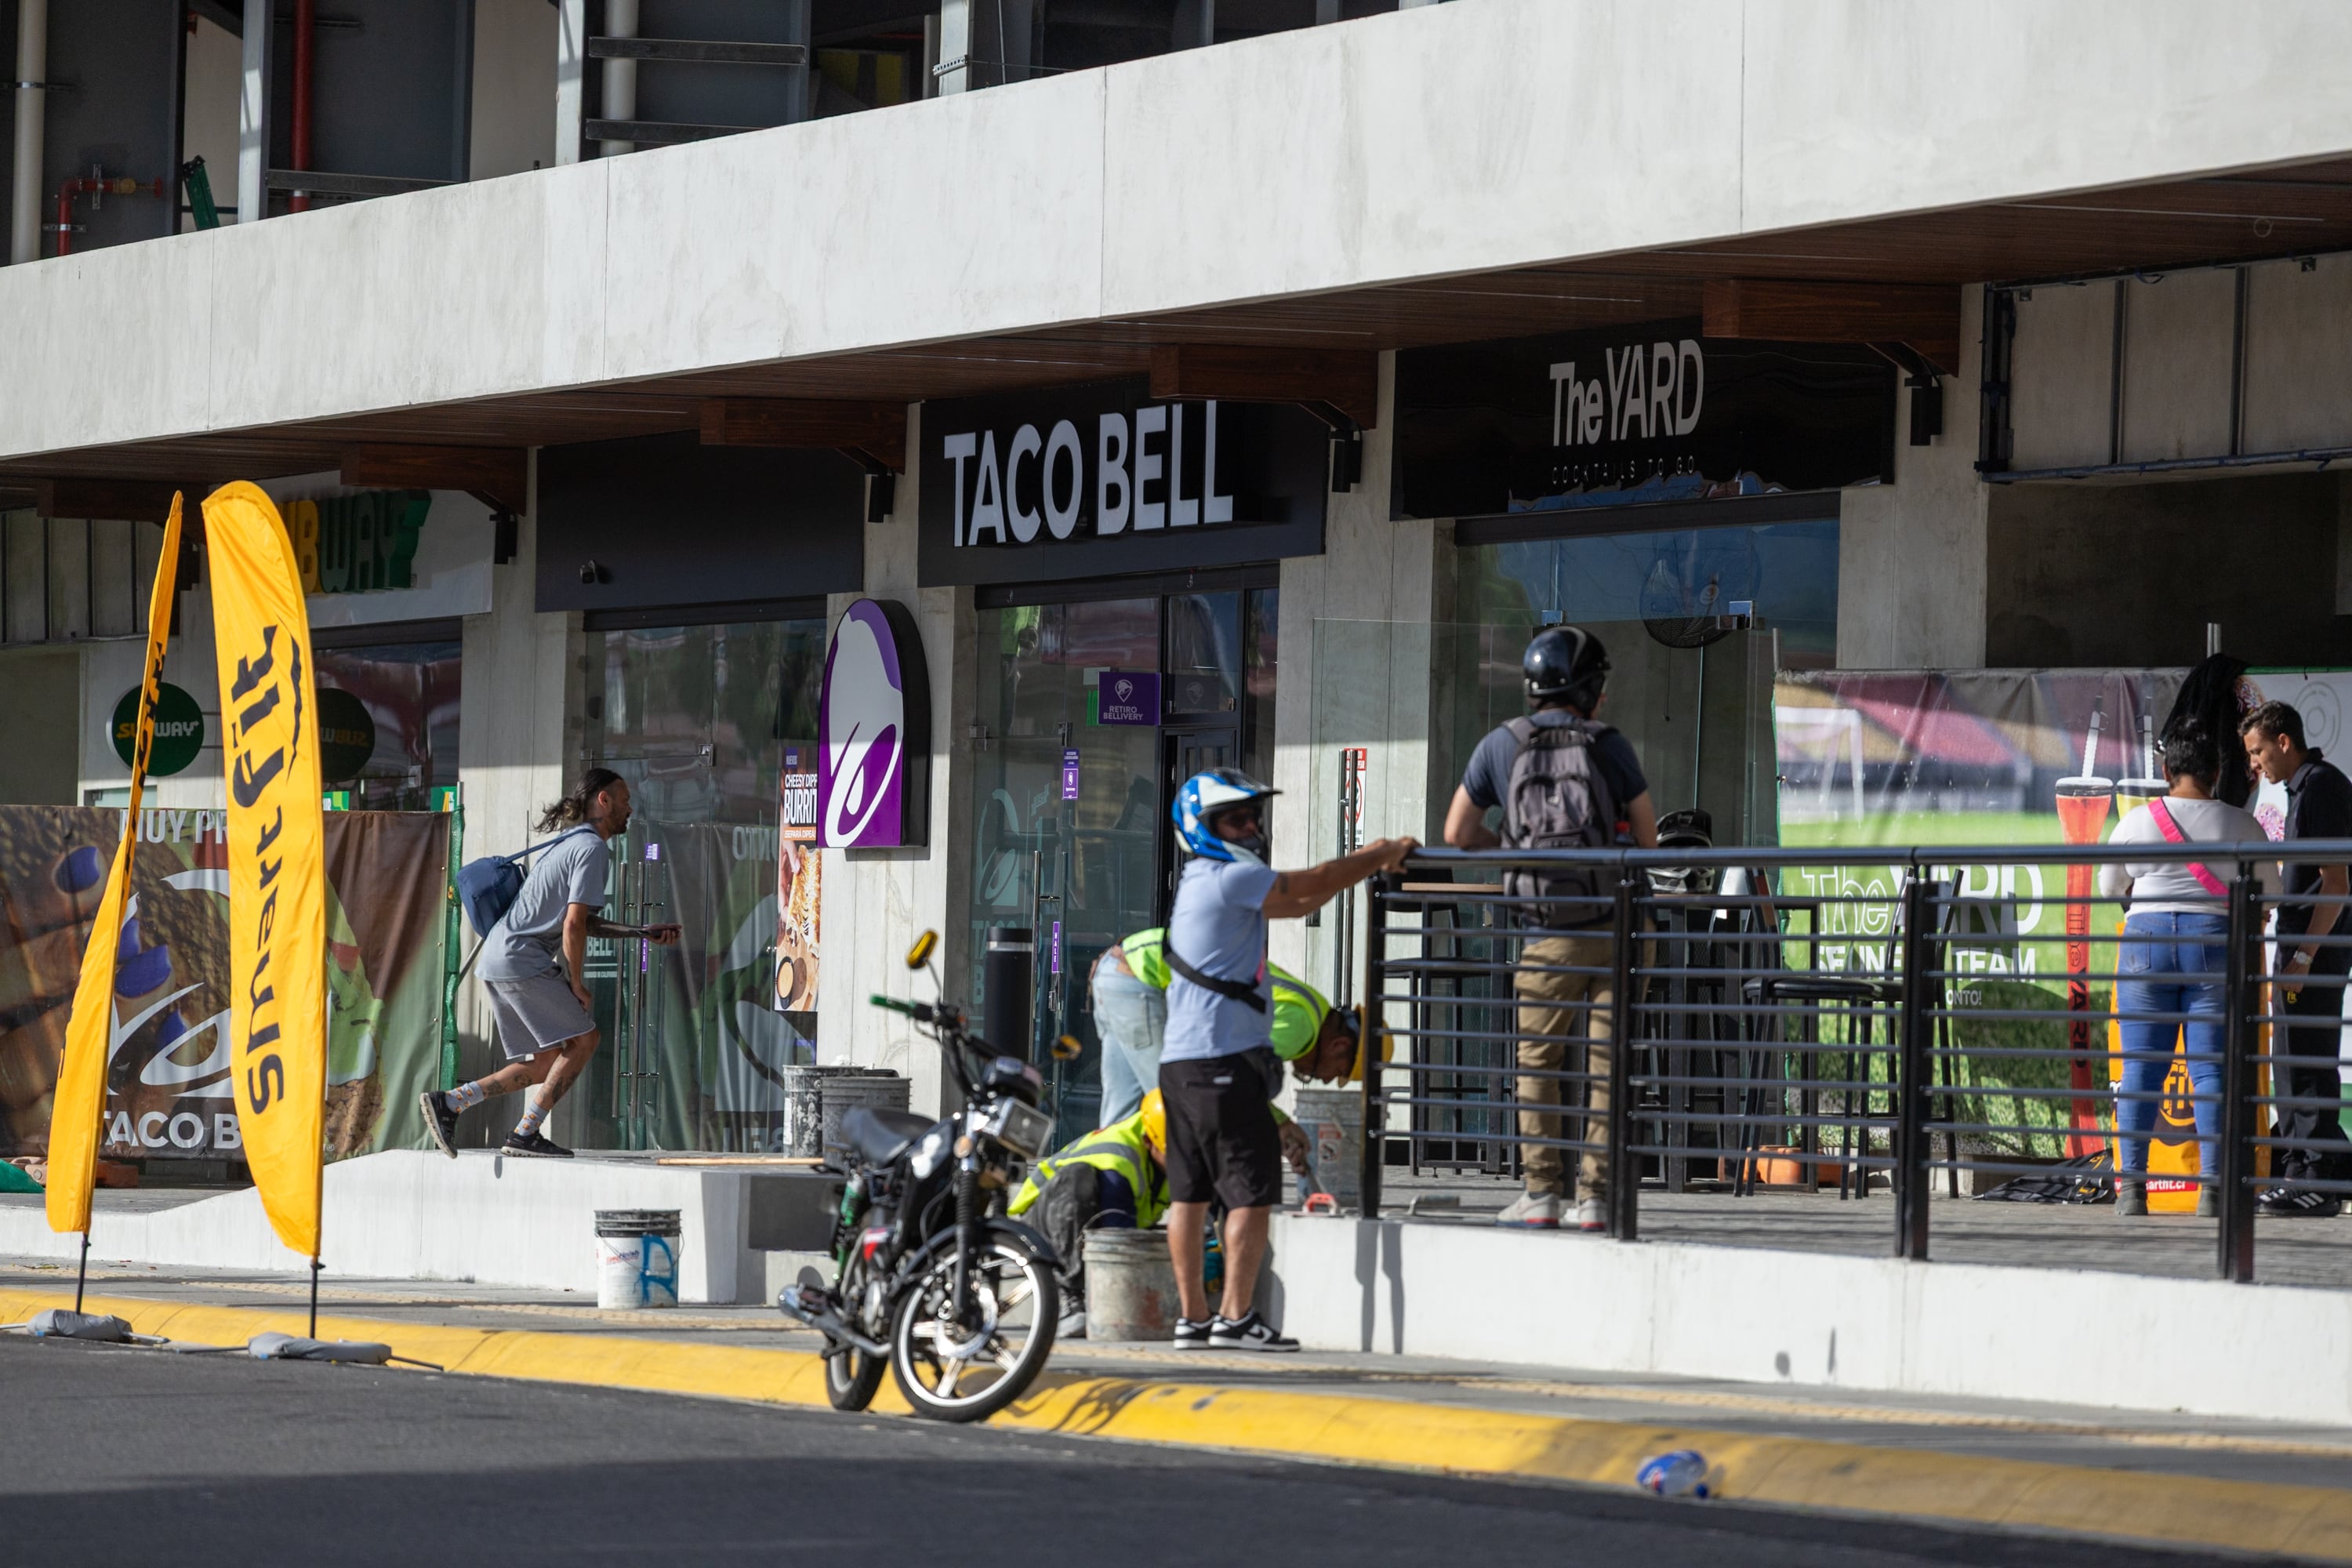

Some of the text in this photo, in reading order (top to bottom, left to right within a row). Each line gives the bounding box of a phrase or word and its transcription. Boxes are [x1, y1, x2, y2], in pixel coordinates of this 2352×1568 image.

[944, 400, 1233, 546] TACO BELL
[785, 773, 806, 788] CHEESY
[1951, 947, 2036, 983] TEAM
